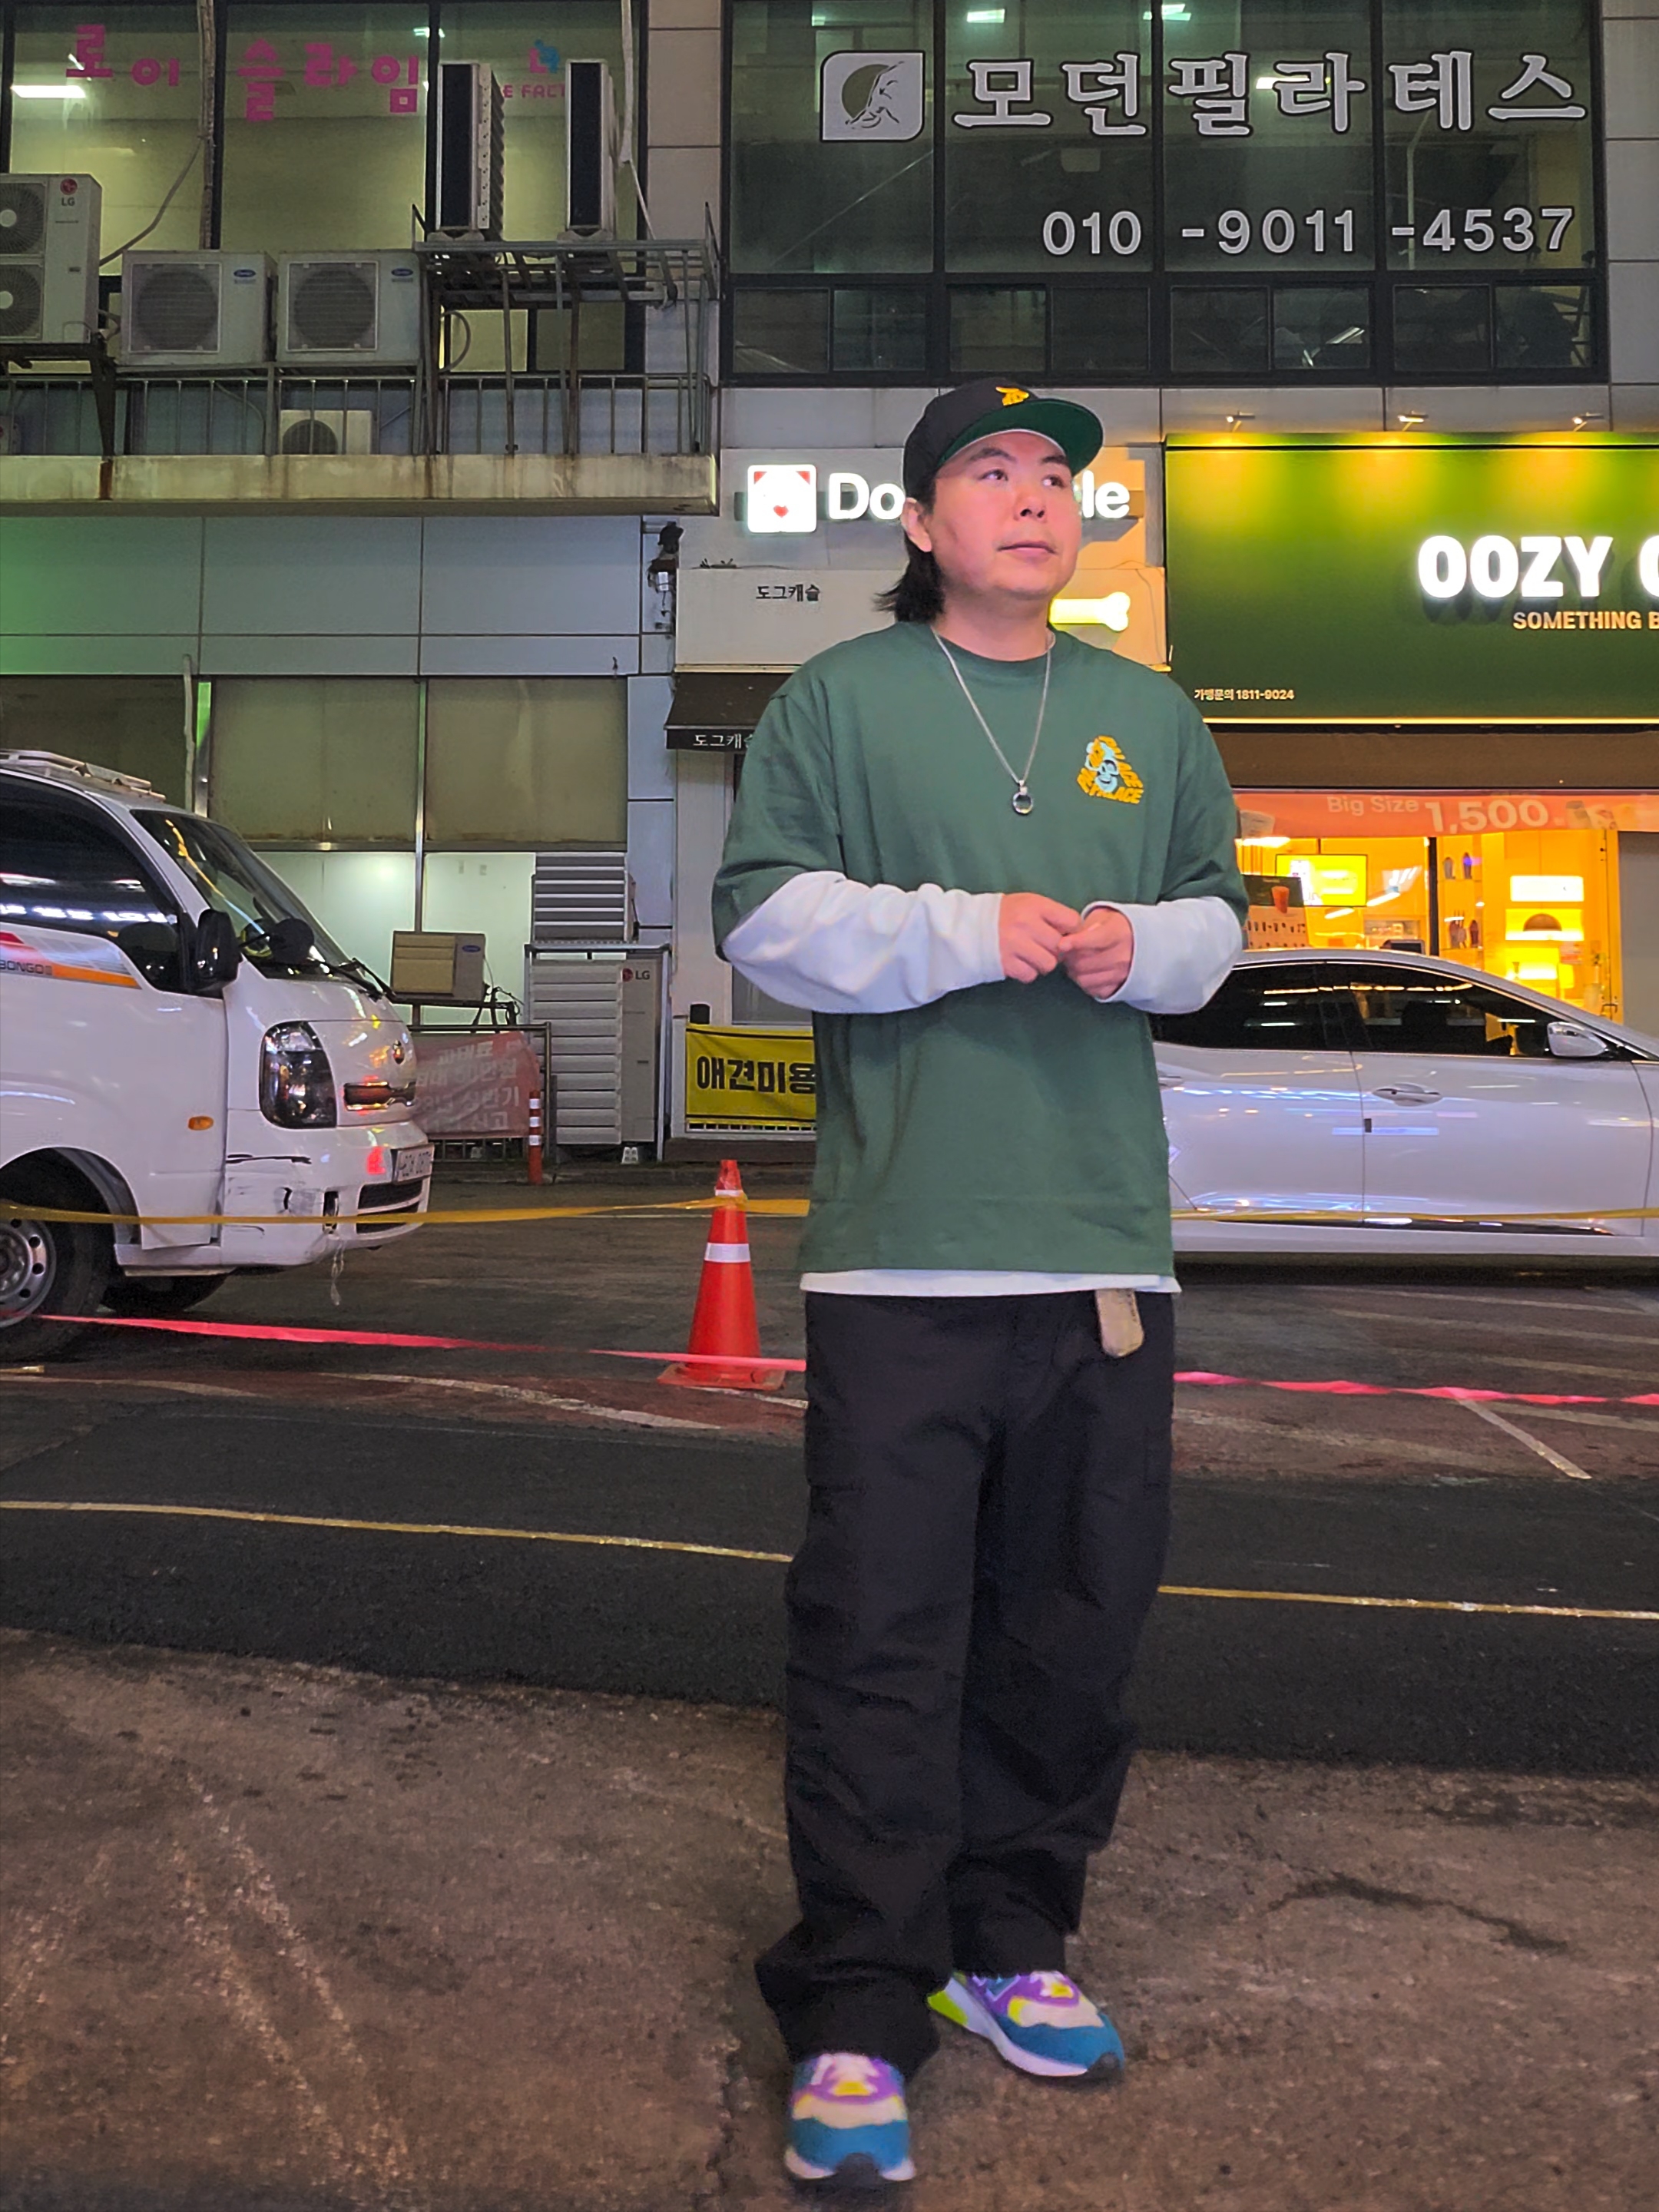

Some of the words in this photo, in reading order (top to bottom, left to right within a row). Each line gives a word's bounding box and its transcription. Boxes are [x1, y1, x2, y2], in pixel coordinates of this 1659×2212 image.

[66, 24, 179, 87] 로이
[237, 38, 419, 122] 슬라임
[503, 84, 514, 98] E
[522, 84, 566, 98] FACT
[953, 51, 1586, 136] 모던필라테스
[61, 197, 75, 207] LG
[829, 472, 906, 520] Do
[1074, 470, 1131, 518] le
[1418, 535, 1614, 598] OOZY
[756, 584, 820, 601] 도그캐슬
[1513, 611, 1642, 630] SOMETHING
[1236, 689, 1295, 700] 1811-9024
[1327, 796, 1364, 816] Big
[1370, 795, 1419, 813] Size
[635, 970, 651, 980] LG
[697, 1055, 816, 1094] 애견미용
